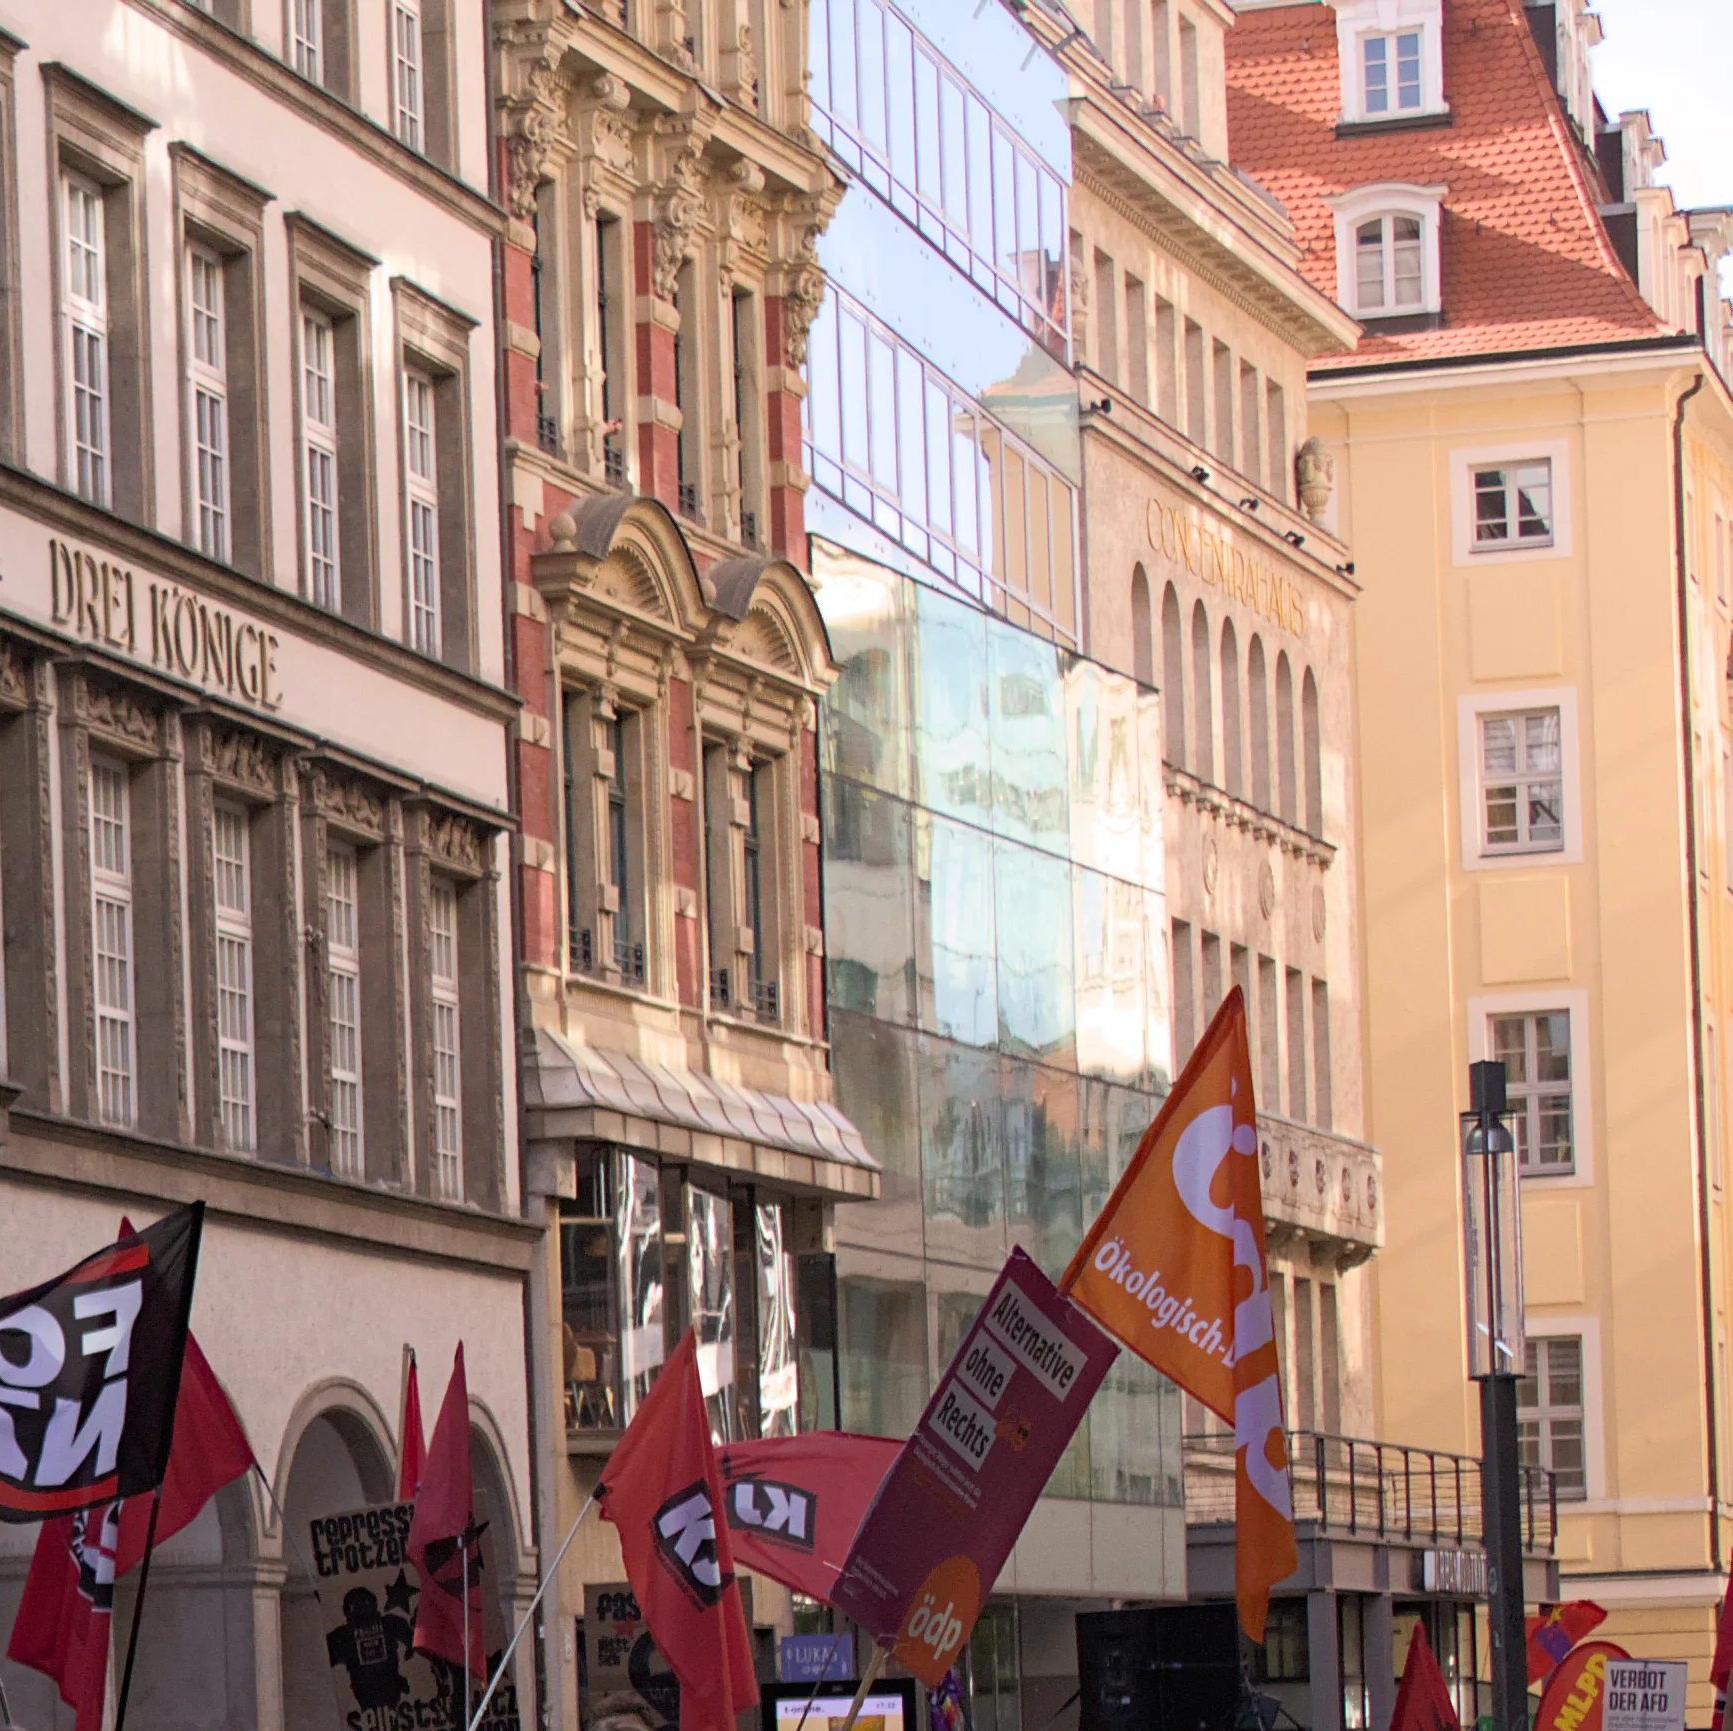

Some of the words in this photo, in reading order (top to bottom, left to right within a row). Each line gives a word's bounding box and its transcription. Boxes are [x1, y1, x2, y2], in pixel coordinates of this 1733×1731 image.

[49, 538, 136, 653] DREI
[150, 583, 284, 712] KÖNIGE
[991, 1292, 1075, 1390] Alternative
[965, 1346, 1005, 1398] ohne
[937, 1391, 990, 1459] Rechts
[310, 1503, 415, 1550] repress
[908, 1592, 962, 1661] ödp
[1609, 1692, 1637, 1712] DER
[1640, 1693, 1669, 1713] AFD
[1611, 1669, 1667, 1690] VERBOT
